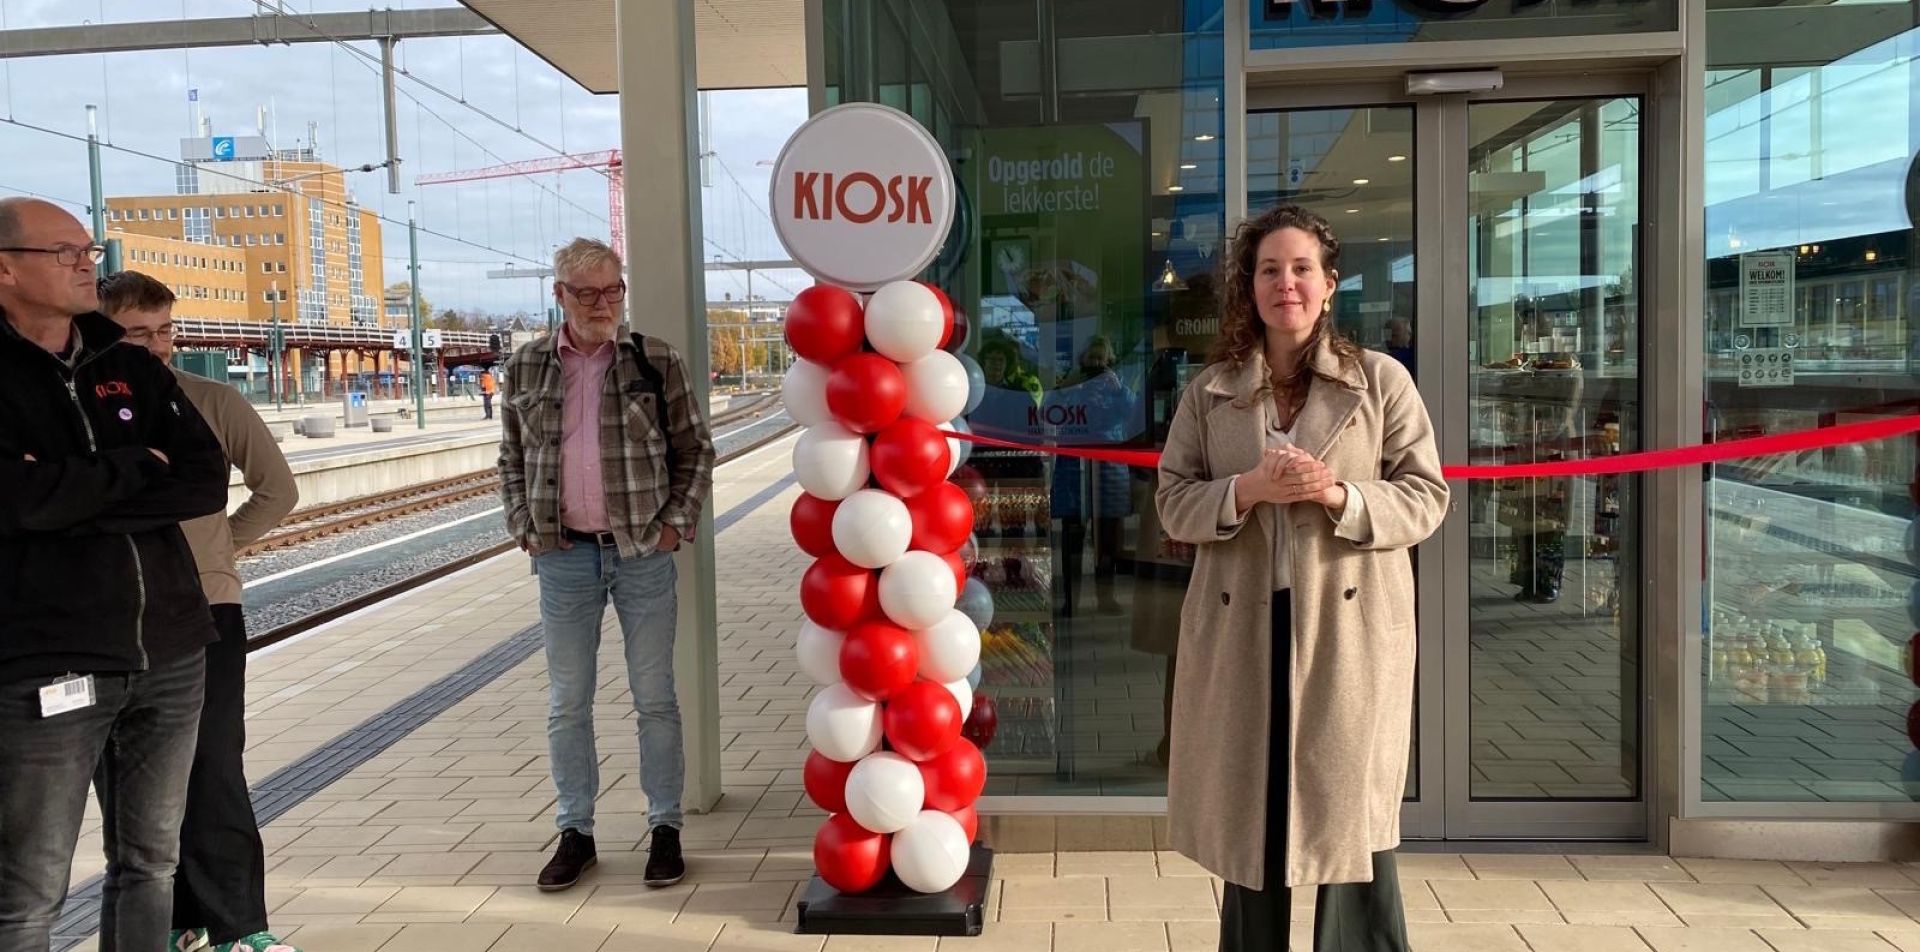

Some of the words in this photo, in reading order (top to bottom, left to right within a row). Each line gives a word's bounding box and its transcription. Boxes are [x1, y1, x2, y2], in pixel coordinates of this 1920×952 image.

[989, 151, 1083, 186] Opgerold
[1089, 151, 1114, 178] de
[794, 171, 932, 224] KIOSK
[1003, 183, 1100, 213] lekkerste!
[1749, 269, 1785, 281] WELKOM!
[399, 336, 407, 346] 4
[427, 335, 435, 346] 5
